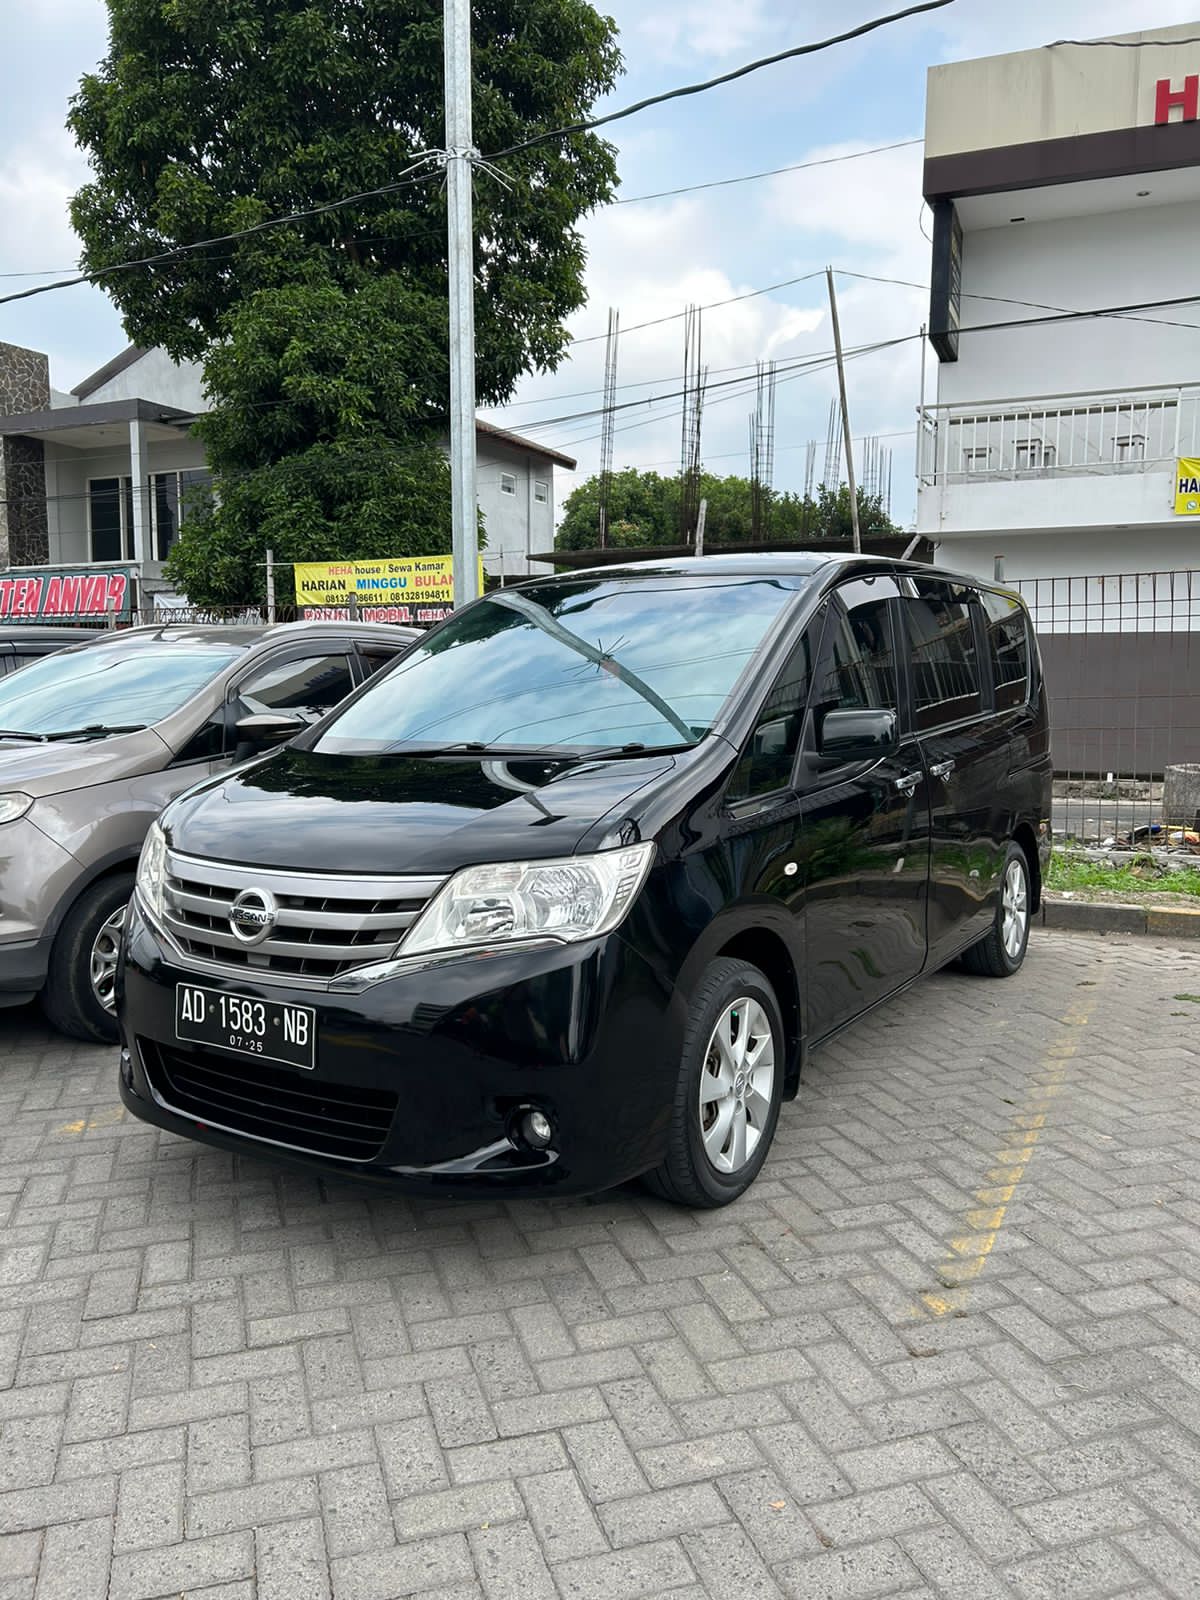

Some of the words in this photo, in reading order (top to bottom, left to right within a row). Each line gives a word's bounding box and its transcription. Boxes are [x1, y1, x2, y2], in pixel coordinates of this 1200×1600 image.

[1179, 478, 1200, 493] HA
[329, 566, 353, 576] HEHA
[355, 565, 381, 575] house
[388, 563, 412, 573] Sewa
[415, 561, 444, 572] Kamar
[302, 580, 346, 591] HARIAN
[356, 577, 407, 590] MINGGU
[43, 574, 127, 617] ANYAR
[181, 988, 206, 1023] AD
[219, 996, 266, 1036] 1583
[283, 1007, 309, 1046] NB
